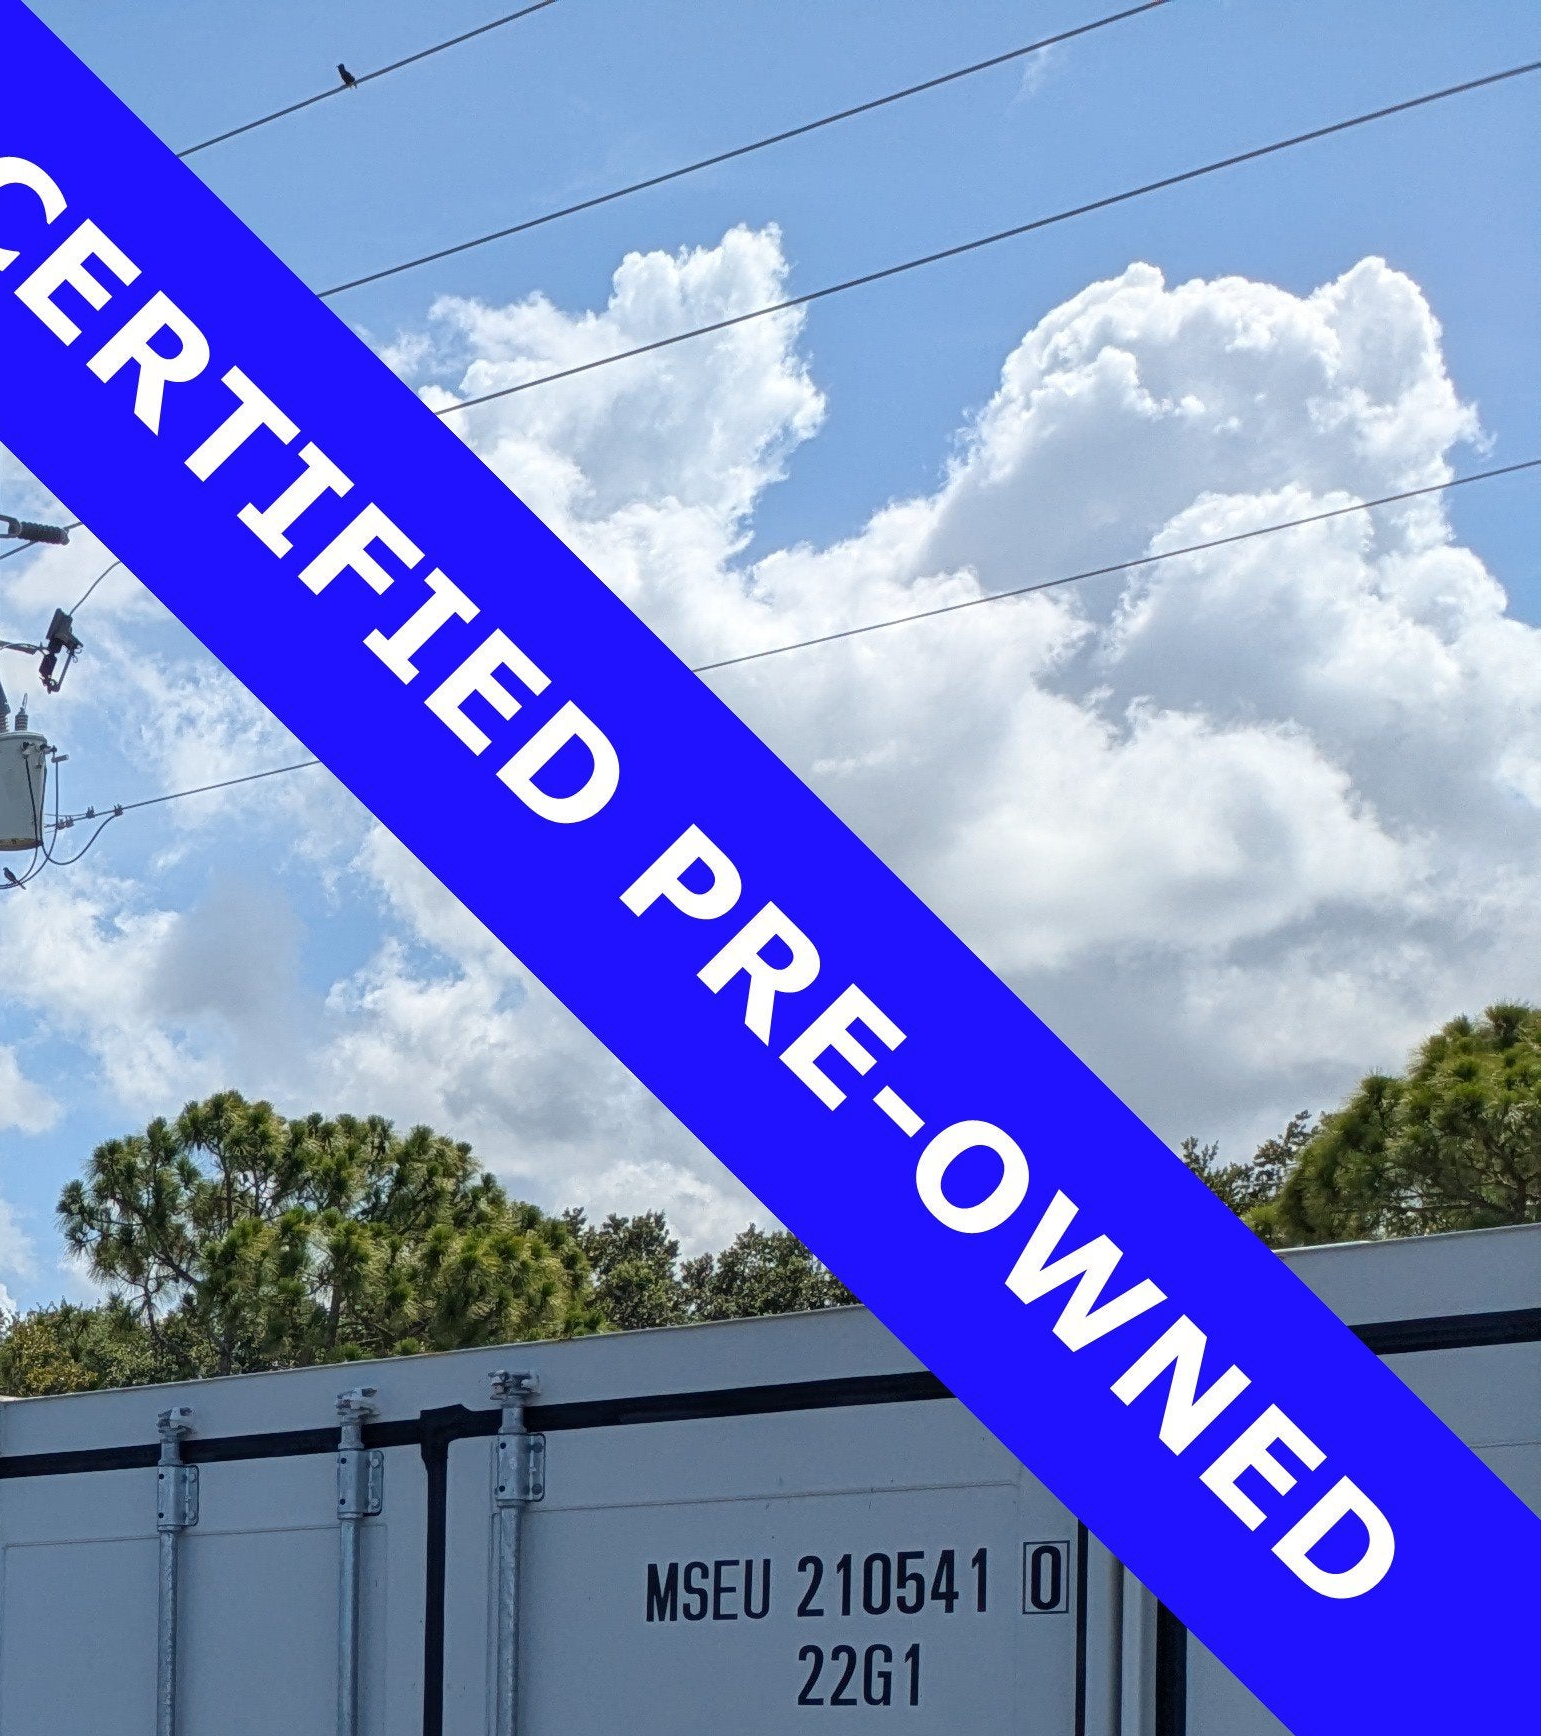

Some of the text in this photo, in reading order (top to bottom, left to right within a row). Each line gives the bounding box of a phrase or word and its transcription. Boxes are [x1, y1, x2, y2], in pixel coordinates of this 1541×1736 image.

[646, 1559, 770, 1622] MSEU
[797, 1548, 987, 1617] 210541
[798, 1644, 919, 1706] 22G1
